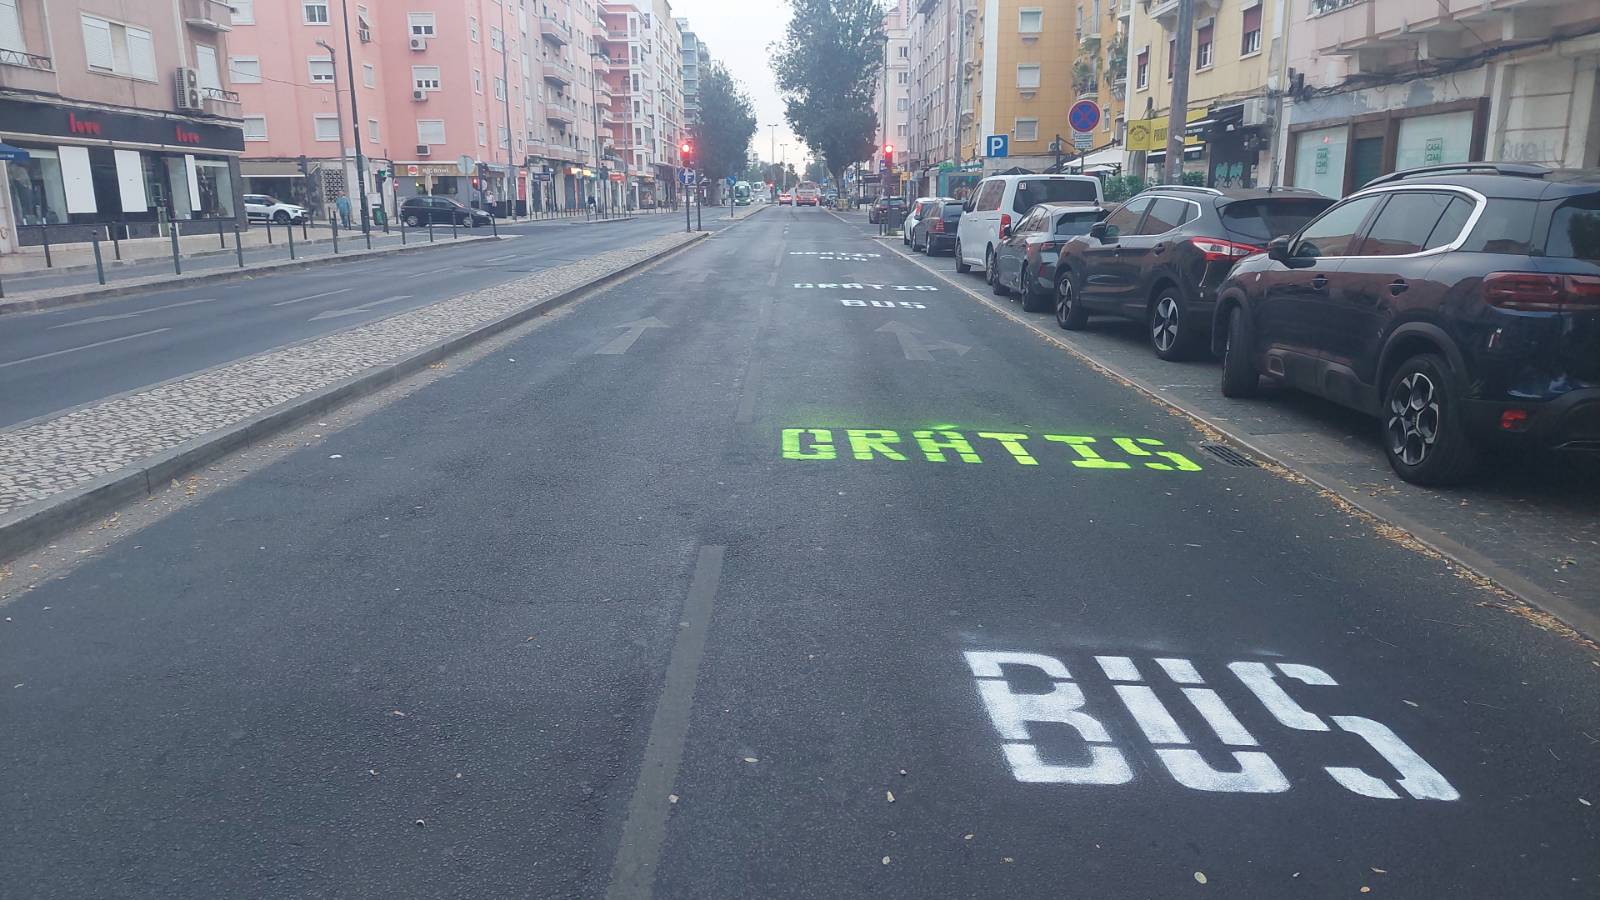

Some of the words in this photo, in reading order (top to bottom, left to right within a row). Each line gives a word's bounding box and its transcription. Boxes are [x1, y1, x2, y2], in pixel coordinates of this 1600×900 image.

[991, 137, 1004, 156] P
[840, 298, 927, 310] BUS
[781, 425, 1203, 472] GRÁTIS
[963, 650, 1461, 802] BUS
